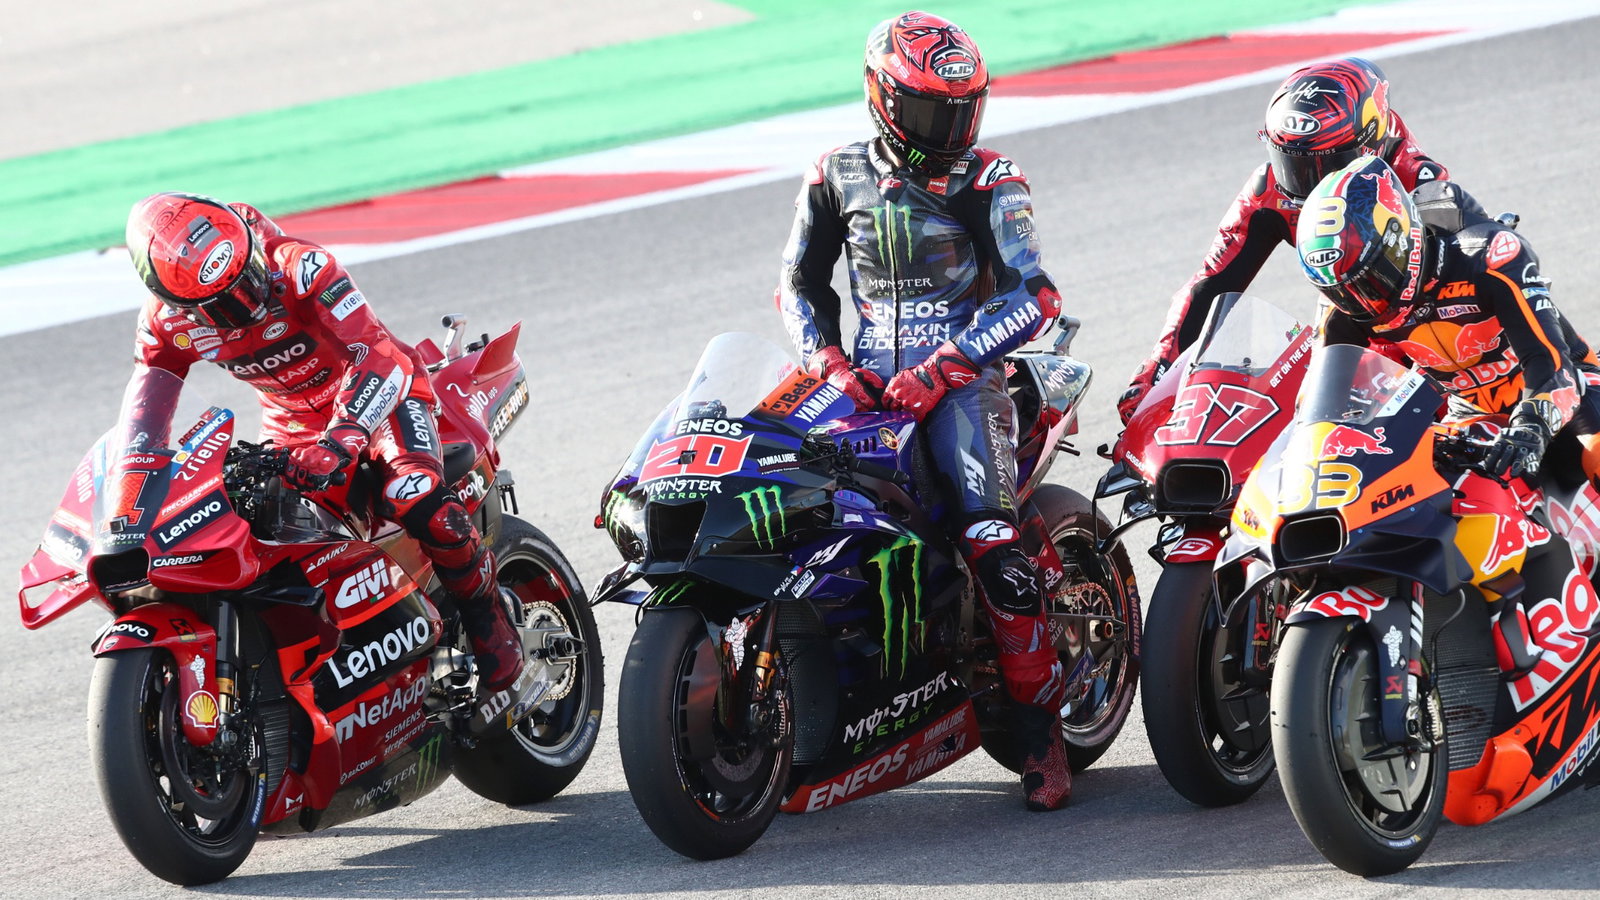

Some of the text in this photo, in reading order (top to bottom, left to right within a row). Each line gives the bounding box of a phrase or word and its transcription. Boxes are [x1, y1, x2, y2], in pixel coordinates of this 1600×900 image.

[941, 64, 973, 76] HJC
[1306, 148, 1336, 156] WINGS
[188, 223, 210, 244] Lenovo
[201, 243, 233, 281] SUOMY
[1308, 250, 1337, 265] HJC
[1400, 227, 1422, 300] Red Bull
[868, 277, 933, 290] MONSTER
[1437, 281, 1476, 300] KTM
[871, 300, 949, 319] ENEOS
[1439, 306, 1467, 319] Mobil
[862, 323, 950, 338] SEMAKIN
[969, 301, 1041, 356] YAMAHA
[233, 342, 306, 375] enovo
[1269, 371, 1283, 388] GET
[1280, 360, 1293, 375] ON
[1289, 348, 1304, 364] THE
[348, 377, 379, 414] Lenovo
[361, 381, 398, 430] UnipolSai
[781, 377, 818, 407] Beta
[794, 384, 843, 424] YAMAHA
[190, 412, 229, 449] ADVANCE
[405, 399, 433, 451] Lenovo
[676, 418, 744, 436] ENEOS
[1153, 382, 1282, 447] 37
[187, 432, 231, 472] riello
[638, 433, 755, 486] 20
[757, 453, 798, 467] YAMALUBE
[987, 412, 1007, 486] MONSTER
[1126, 450, 1147, 472] GASGA
[161, 477, 220, 517] FRECCIAROSSA
[458, 474, 485, 501] novo
[642, 479, 723, 496] MONSTER
[649, 492, 709, 501] ENERGY
[1371, 484, 1415, 514] KTM
[159, 500, 222, 544] Lenovo
[153, 554, 203, 567] CARRERA
[335, 557, 390, 609] GIVI
[109, 623, 149, 638] novo
[1130, 596, 1140, 657] MICHELIN
[327, 616, 430, 689] Lenovo
[348, 676, 427, 729] NetApp
[385, 708, 421, 742] SIEMENS
[853, 703, 933, 754] EERGY
[805, 743, 910, 813] ENEOS
[1550, 728, 1595, 793] Mobil
[353, 763, 417, 809] MONSTER
